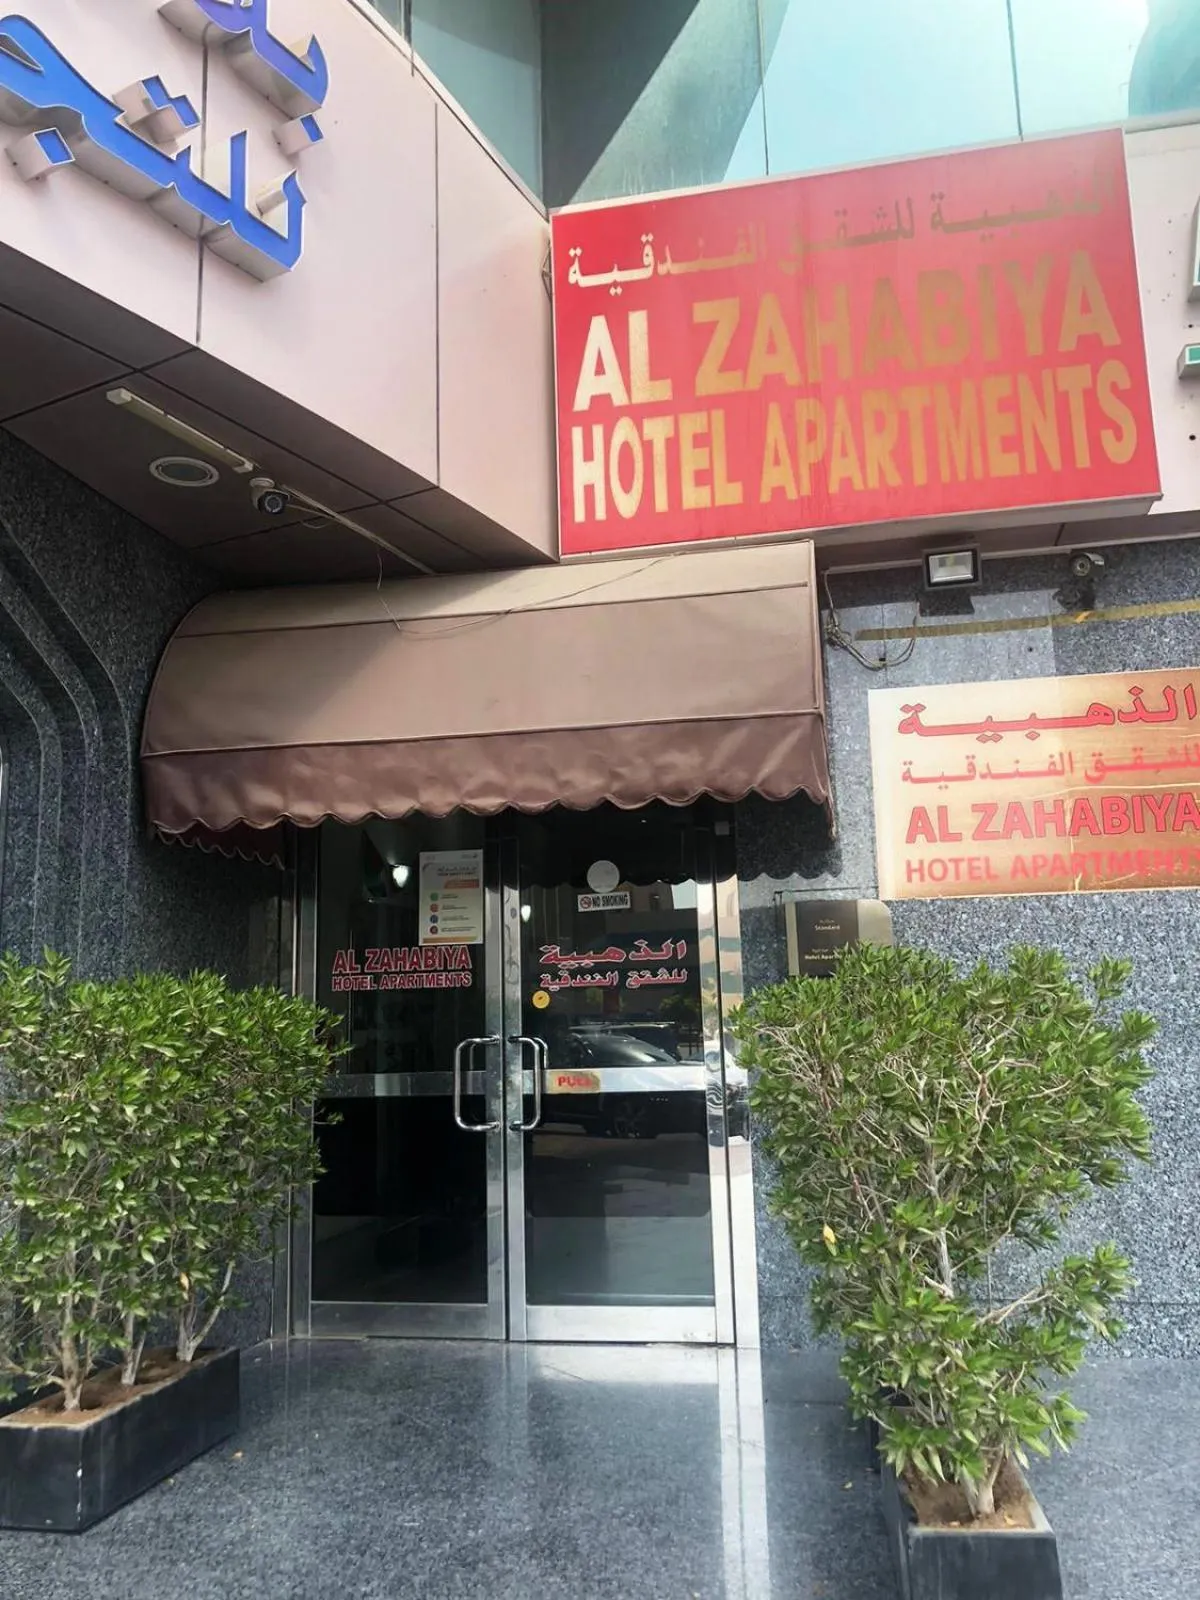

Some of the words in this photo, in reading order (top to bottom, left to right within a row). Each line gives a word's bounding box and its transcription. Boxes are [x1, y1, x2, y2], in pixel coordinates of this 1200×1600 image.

[568, 218, 766, 296] الفندقية
[572, 310, 673, 413] AL
[692, 250, 1123, 398] ZAHABIYA
[571, 411, 744, 524] HOTEL
[759, 360, 1138, 503] APARTMENTS
[898, 682, 1198, 744] الذهبية
[901, 751, 1074, 791] الفندقية
[905, 805, 963, 844] AL
[970, 793, 1200, 841] ZAHABIYA
[905, 856, 999, 884] HOTEL
[332, 949, 361, 975] AL
[364, 945, 473, 973] ZAHABIYA
[539, 938, 688, 969] الذهبية
[332, 974, 378, 992] HOTEL
[379, 971, 472, 990] APARTMENTS
